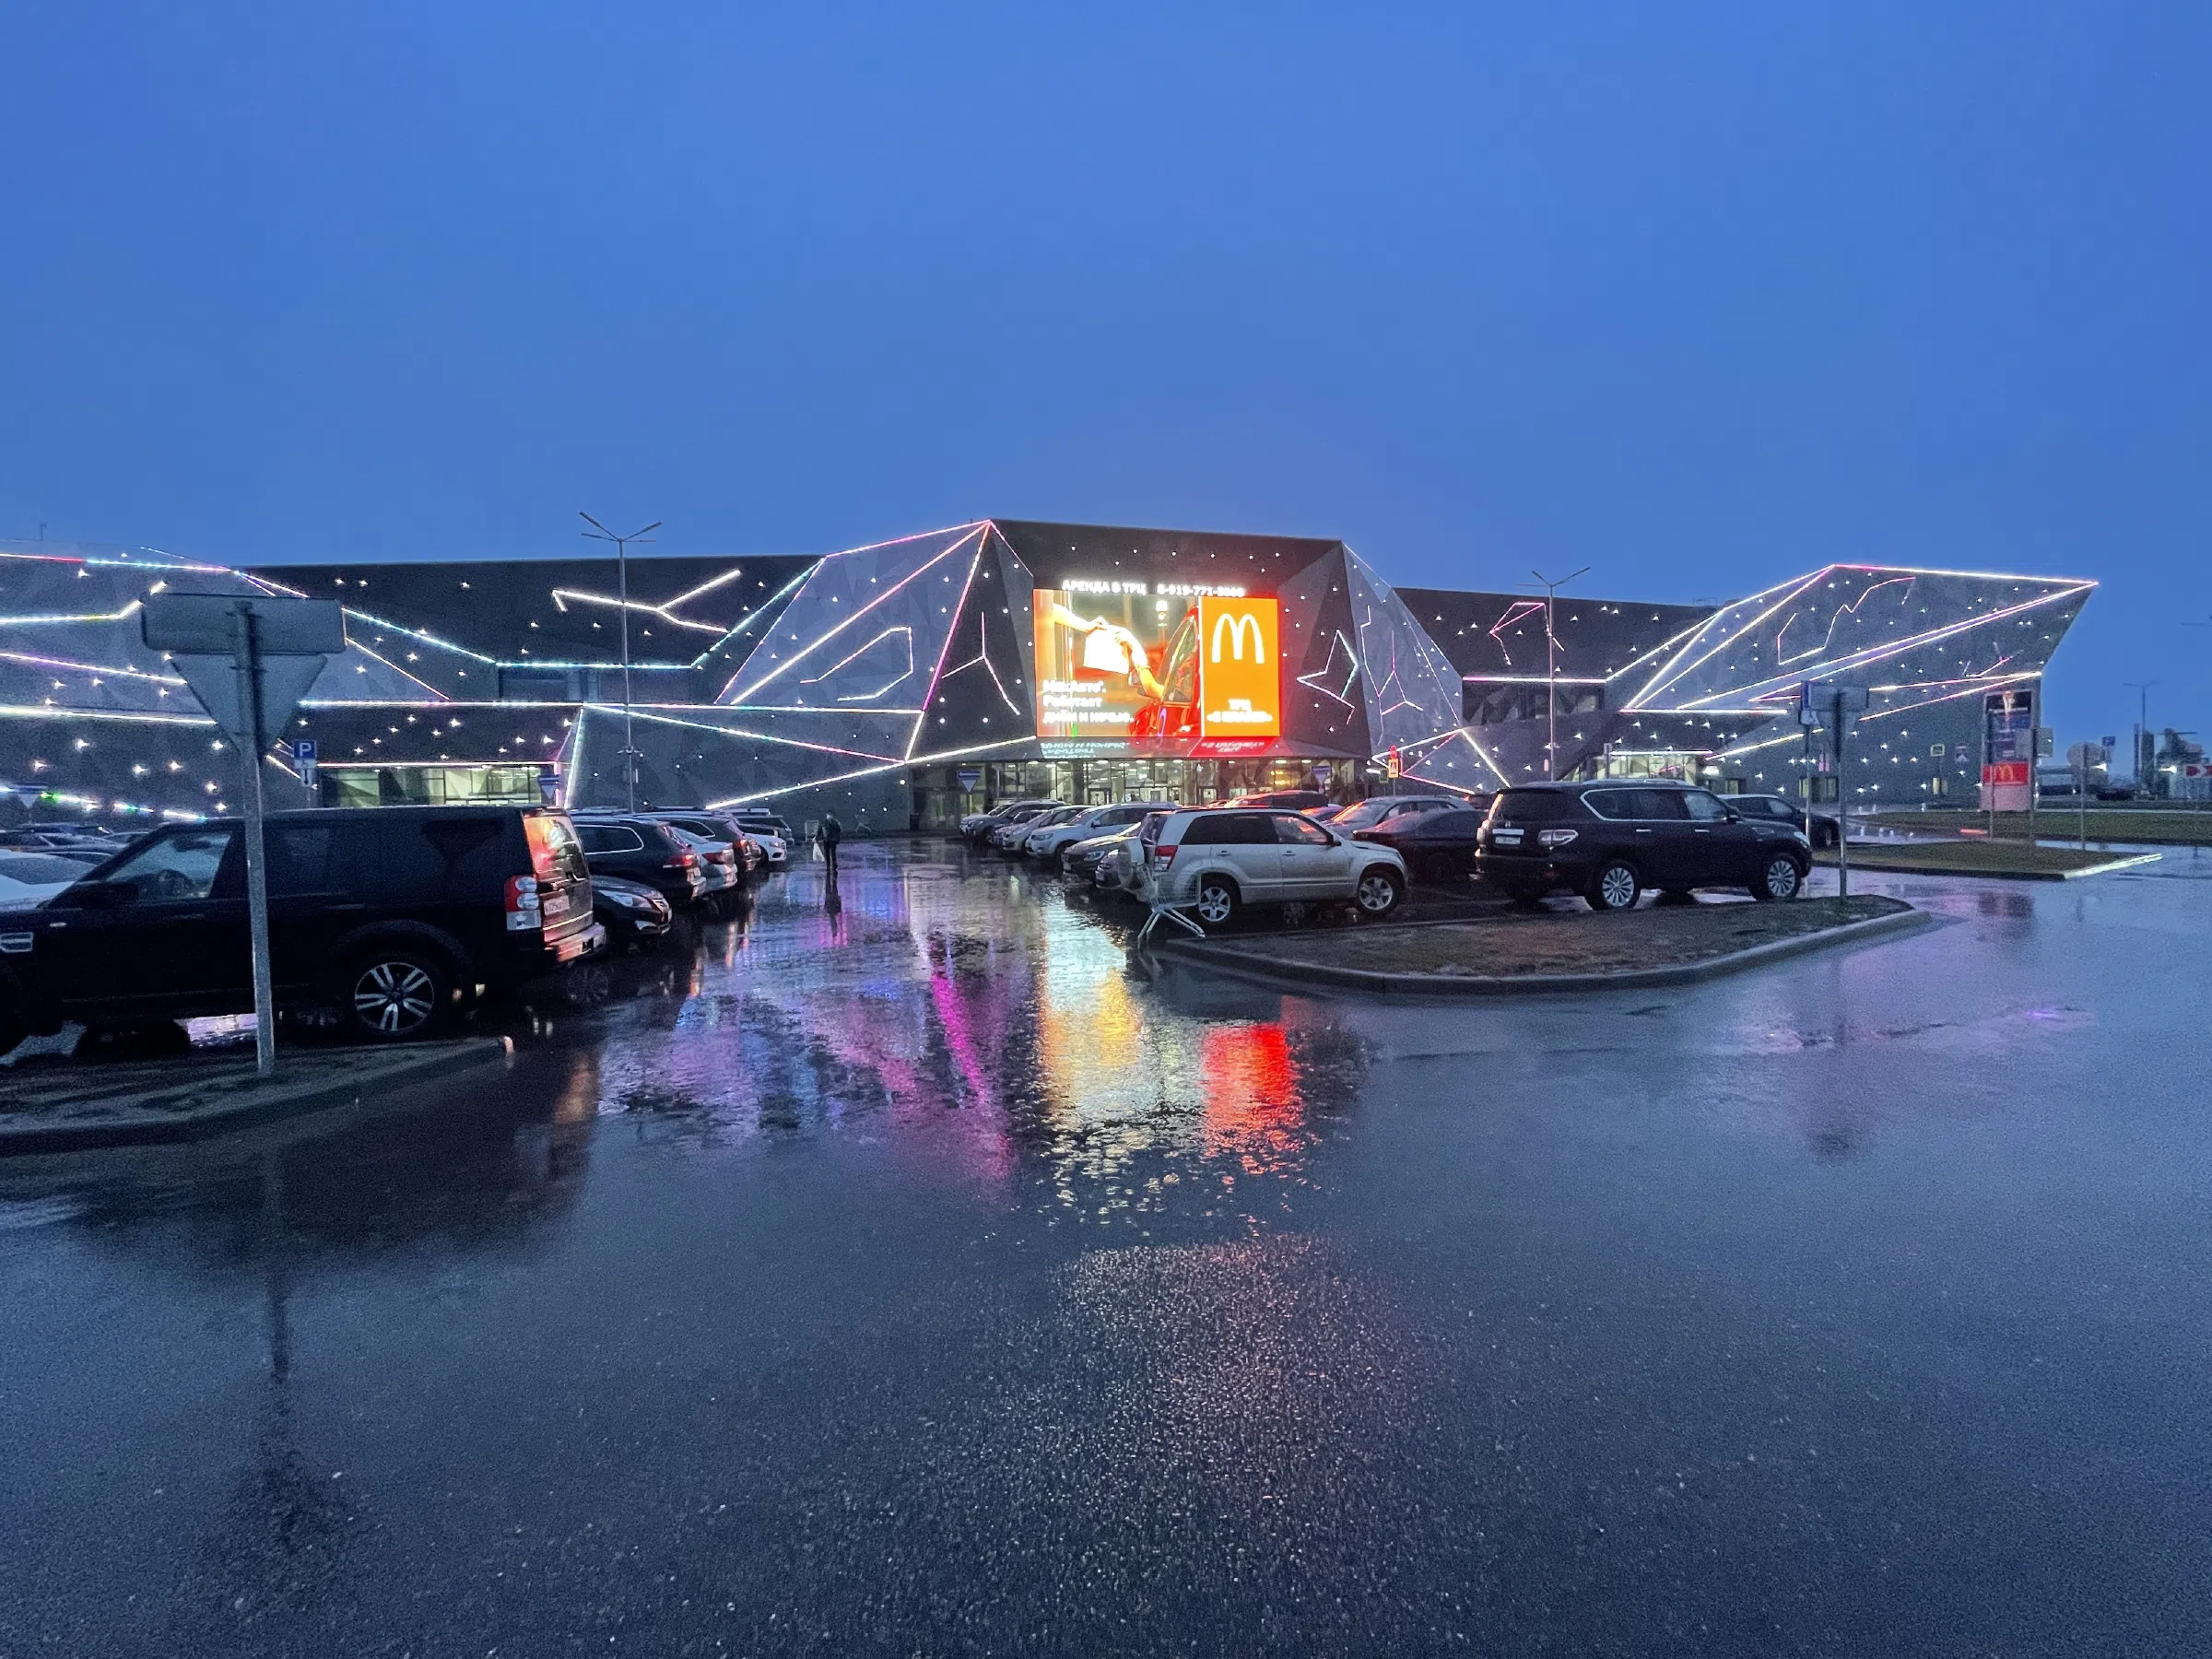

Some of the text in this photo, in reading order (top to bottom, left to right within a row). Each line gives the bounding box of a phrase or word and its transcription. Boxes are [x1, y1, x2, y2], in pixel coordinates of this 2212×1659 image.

[1062, 579, 1111, 594] АРЕНДА
[1112, 581, 1121, 593] В
[1122, 582, 1147, 595] ТРЦ
